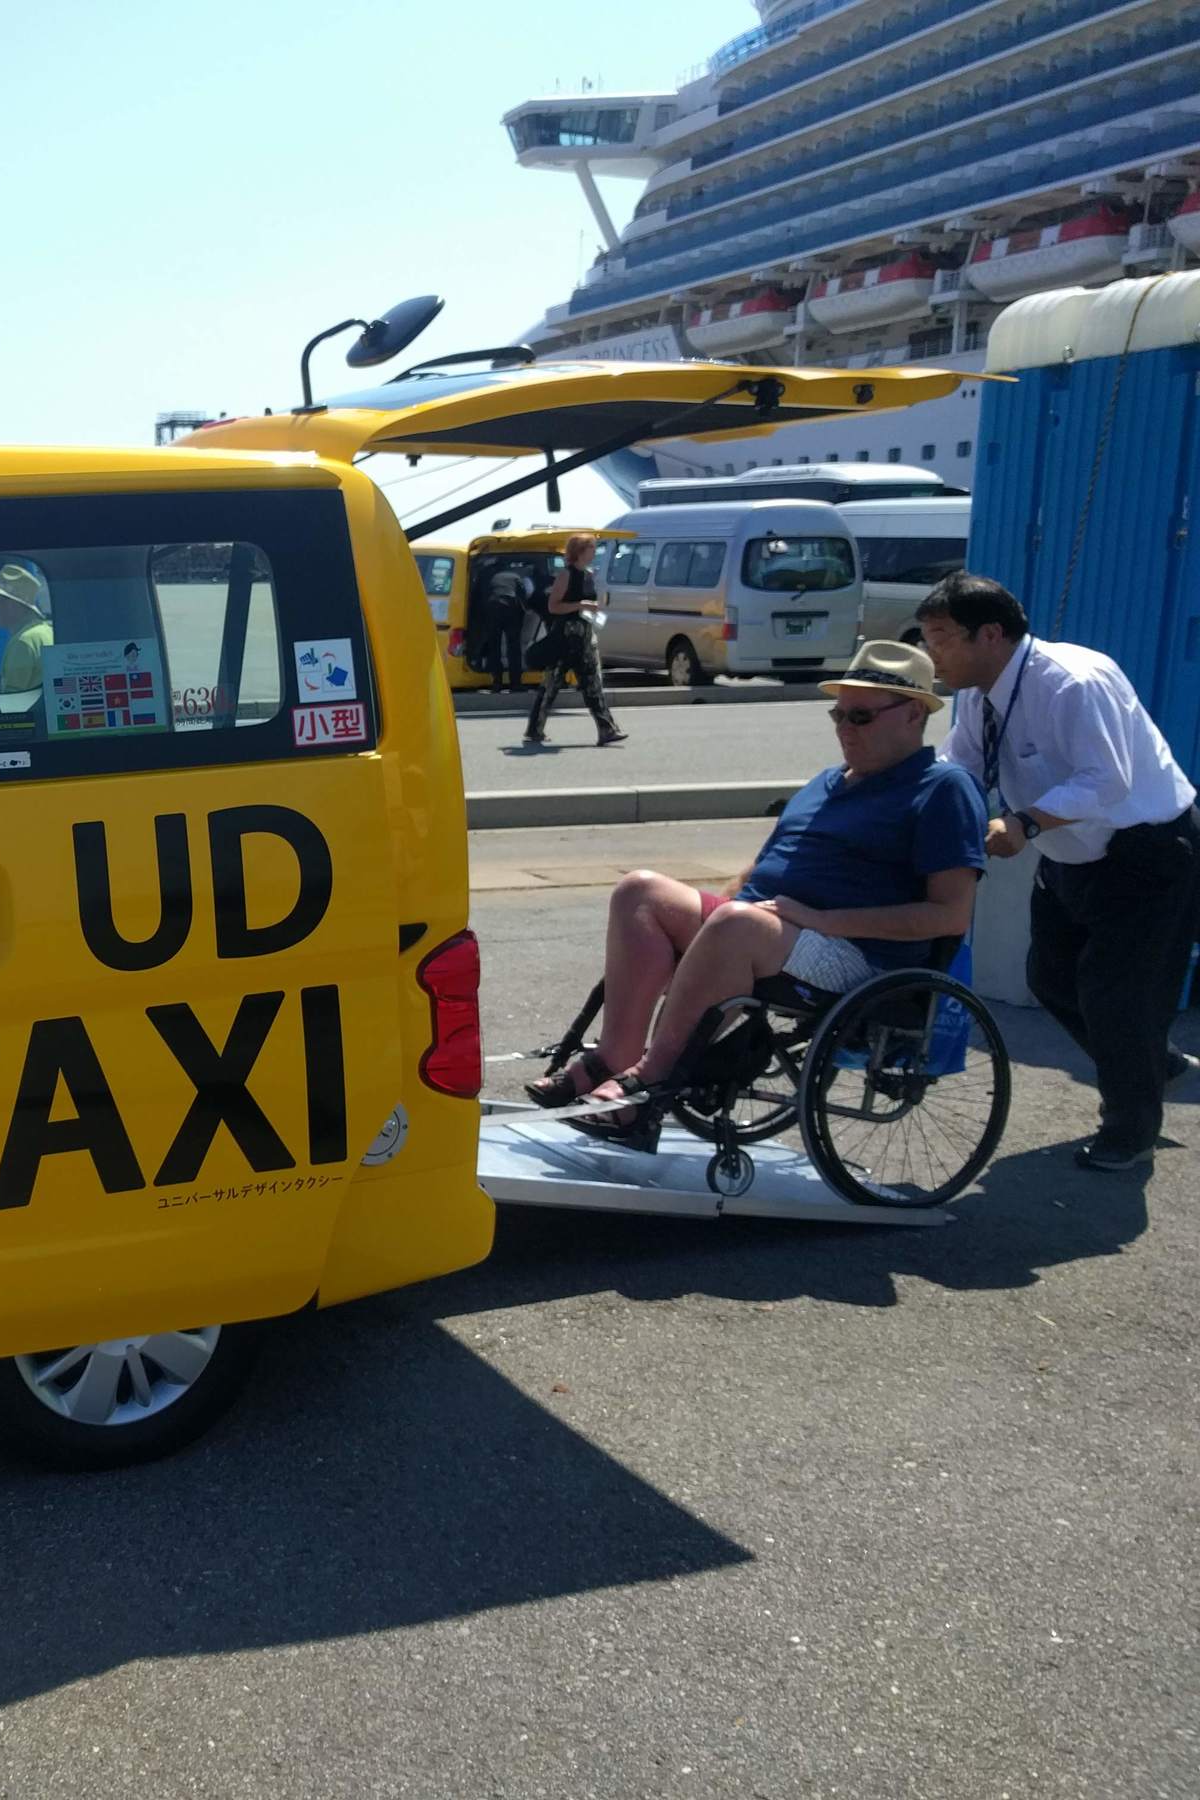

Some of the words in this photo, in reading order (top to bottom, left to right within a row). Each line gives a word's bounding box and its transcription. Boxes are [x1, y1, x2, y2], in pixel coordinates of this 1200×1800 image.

[298, 708, 363, 741] 小型
[72, 804, 333, 971] UD
[157, 1175, 344, 1209] ユニバーサルデザインタクシー
